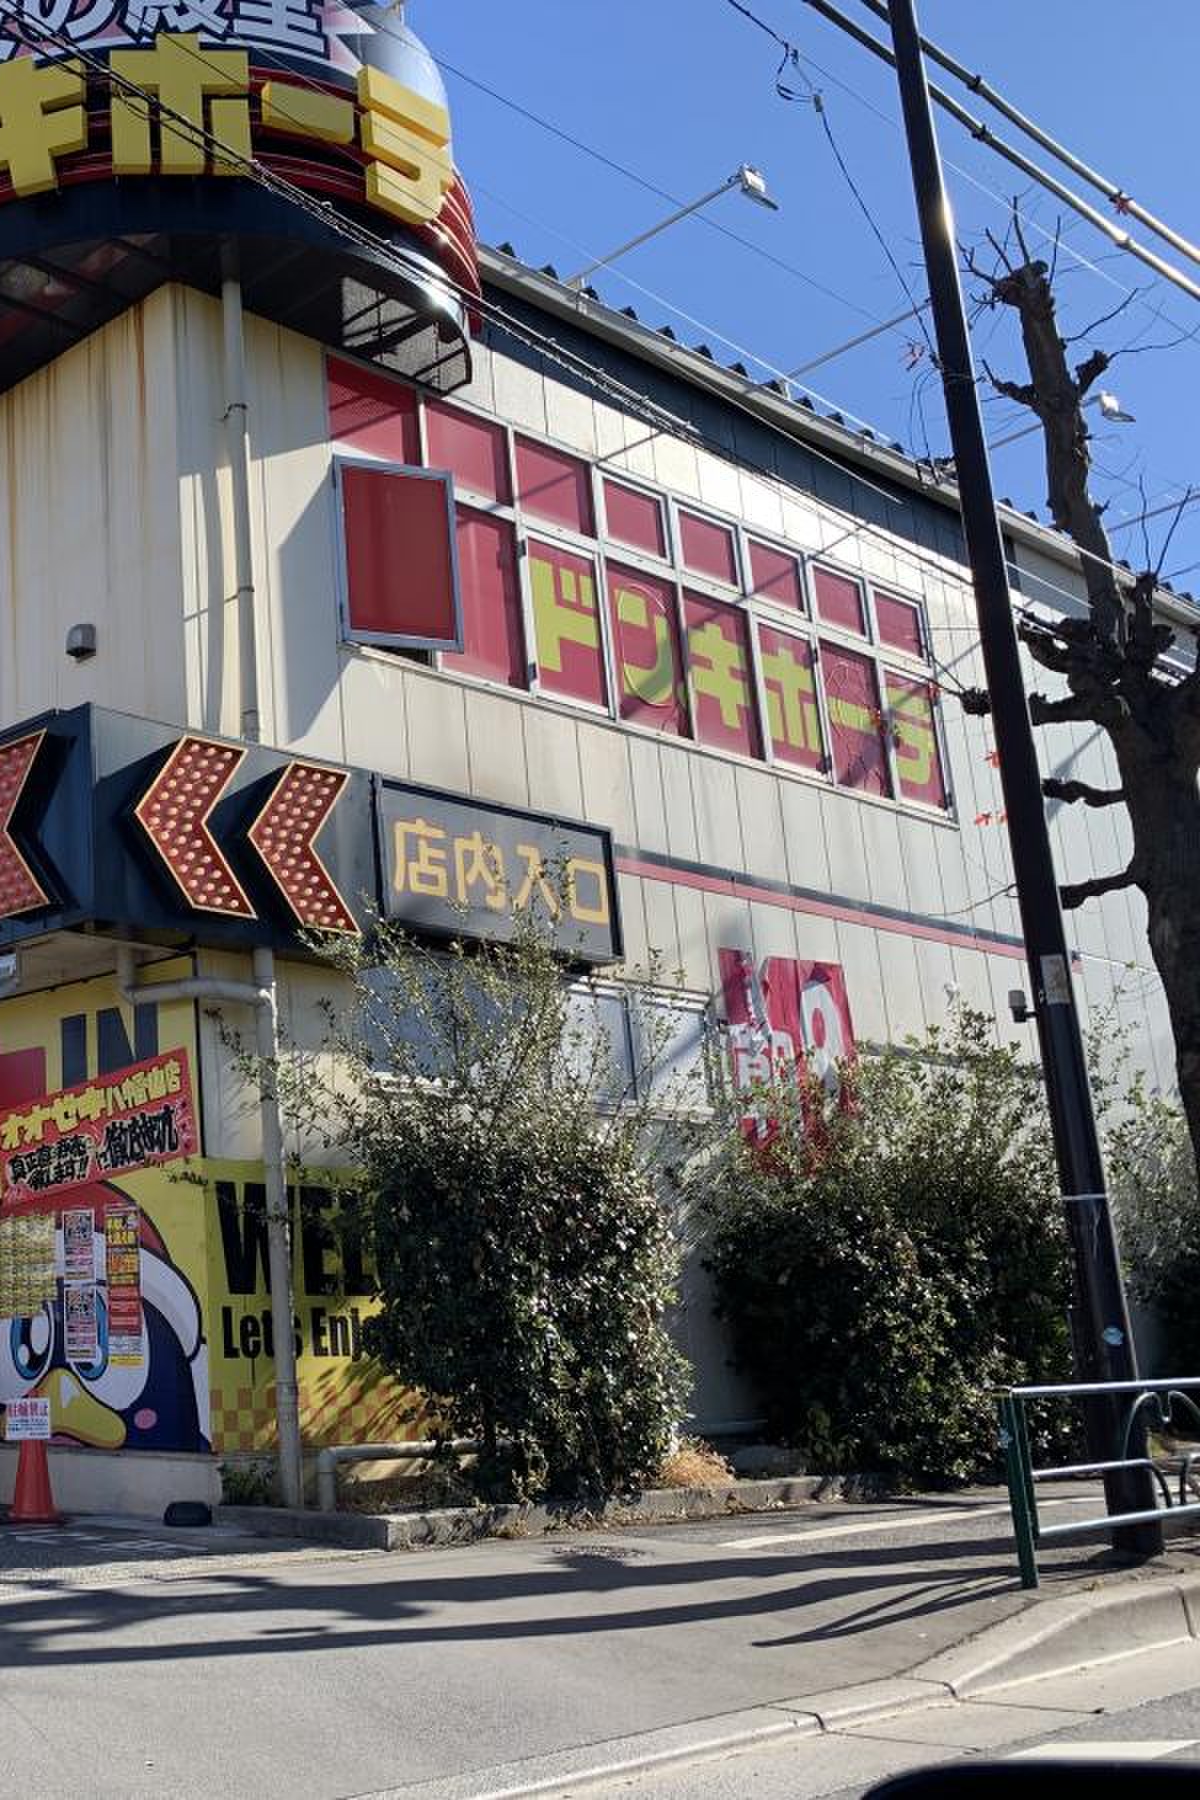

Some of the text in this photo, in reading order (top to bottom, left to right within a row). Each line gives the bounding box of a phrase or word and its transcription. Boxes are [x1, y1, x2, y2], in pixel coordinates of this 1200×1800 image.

[392, 817, 608, 924] 店内入口
[61, 1003, 158, 1089] IN
